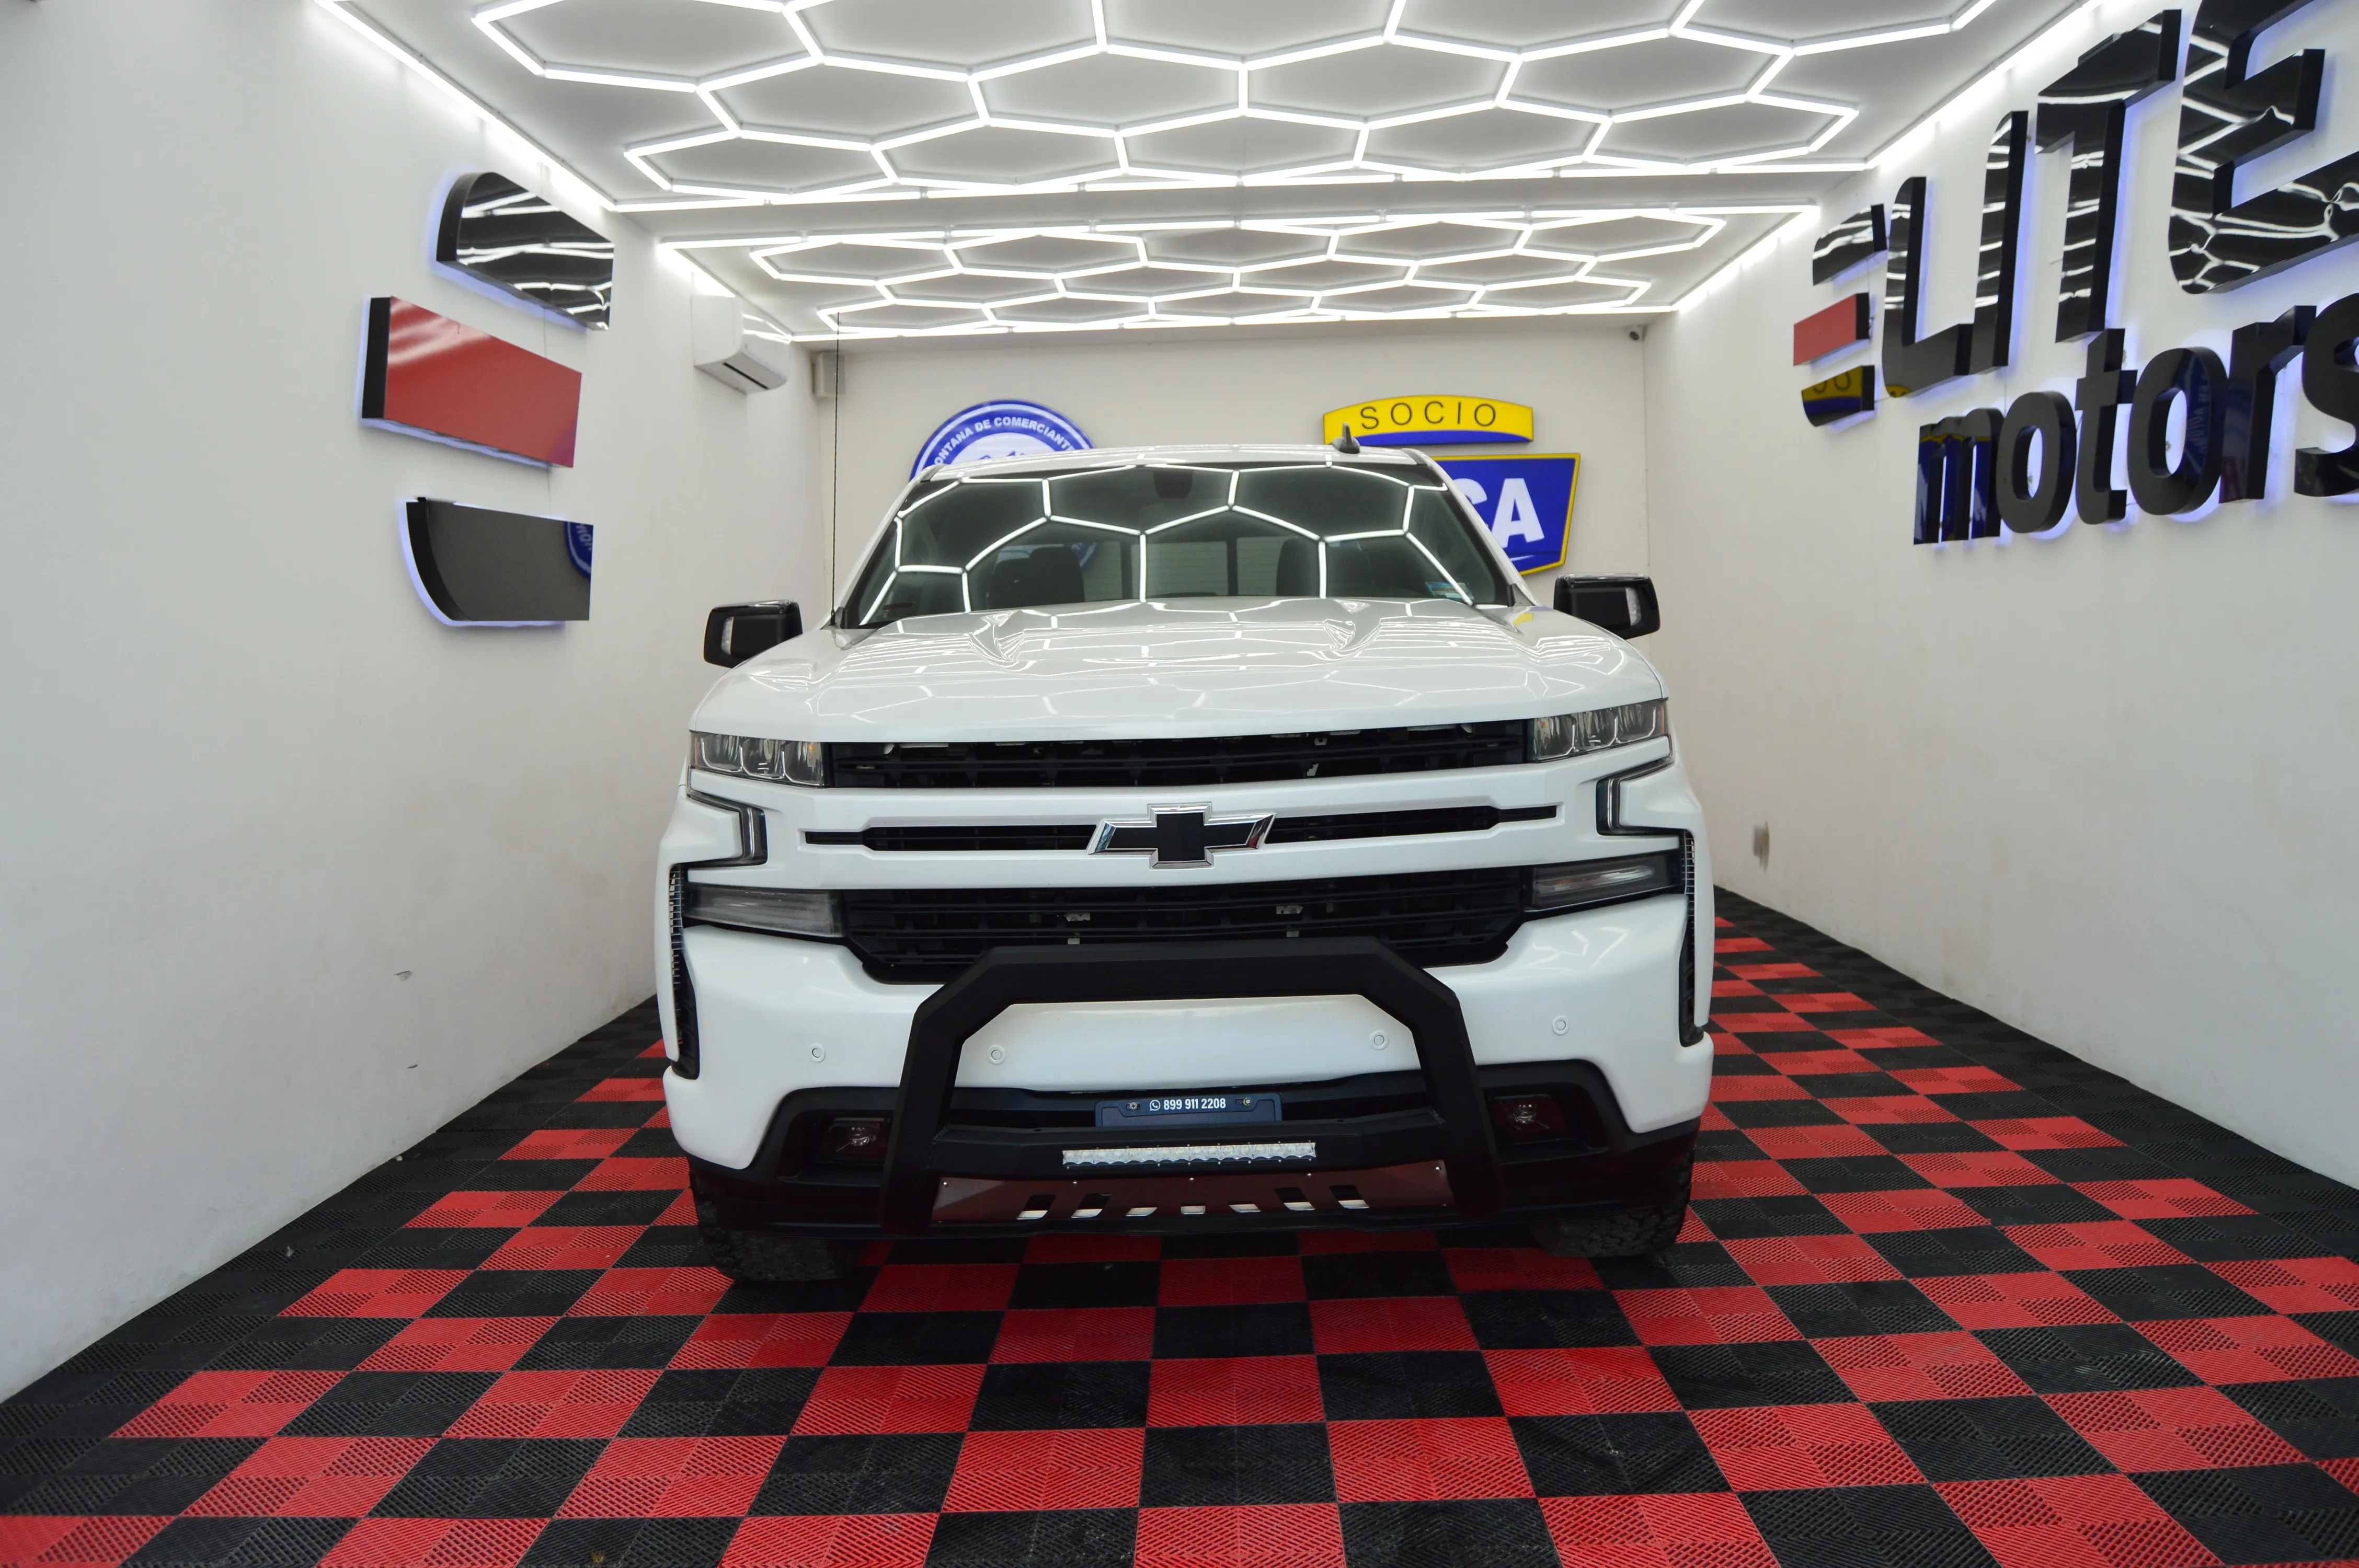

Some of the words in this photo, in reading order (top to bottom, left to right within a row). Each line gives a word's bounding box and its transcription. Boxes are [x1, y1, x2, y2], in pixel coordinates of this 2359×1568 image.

[1360, 400, 1496, 430] SOCIO
[1914, 292, 2359, 545] motors
[933, 427, 974, 465] ONTANA
[974, 419, 992, 433] DE
[1163, 1099, 1182, 1110] 899
[1185, 1098, 1198, 1109] 911
[1201, 1098, 1226, 1109] 2208
